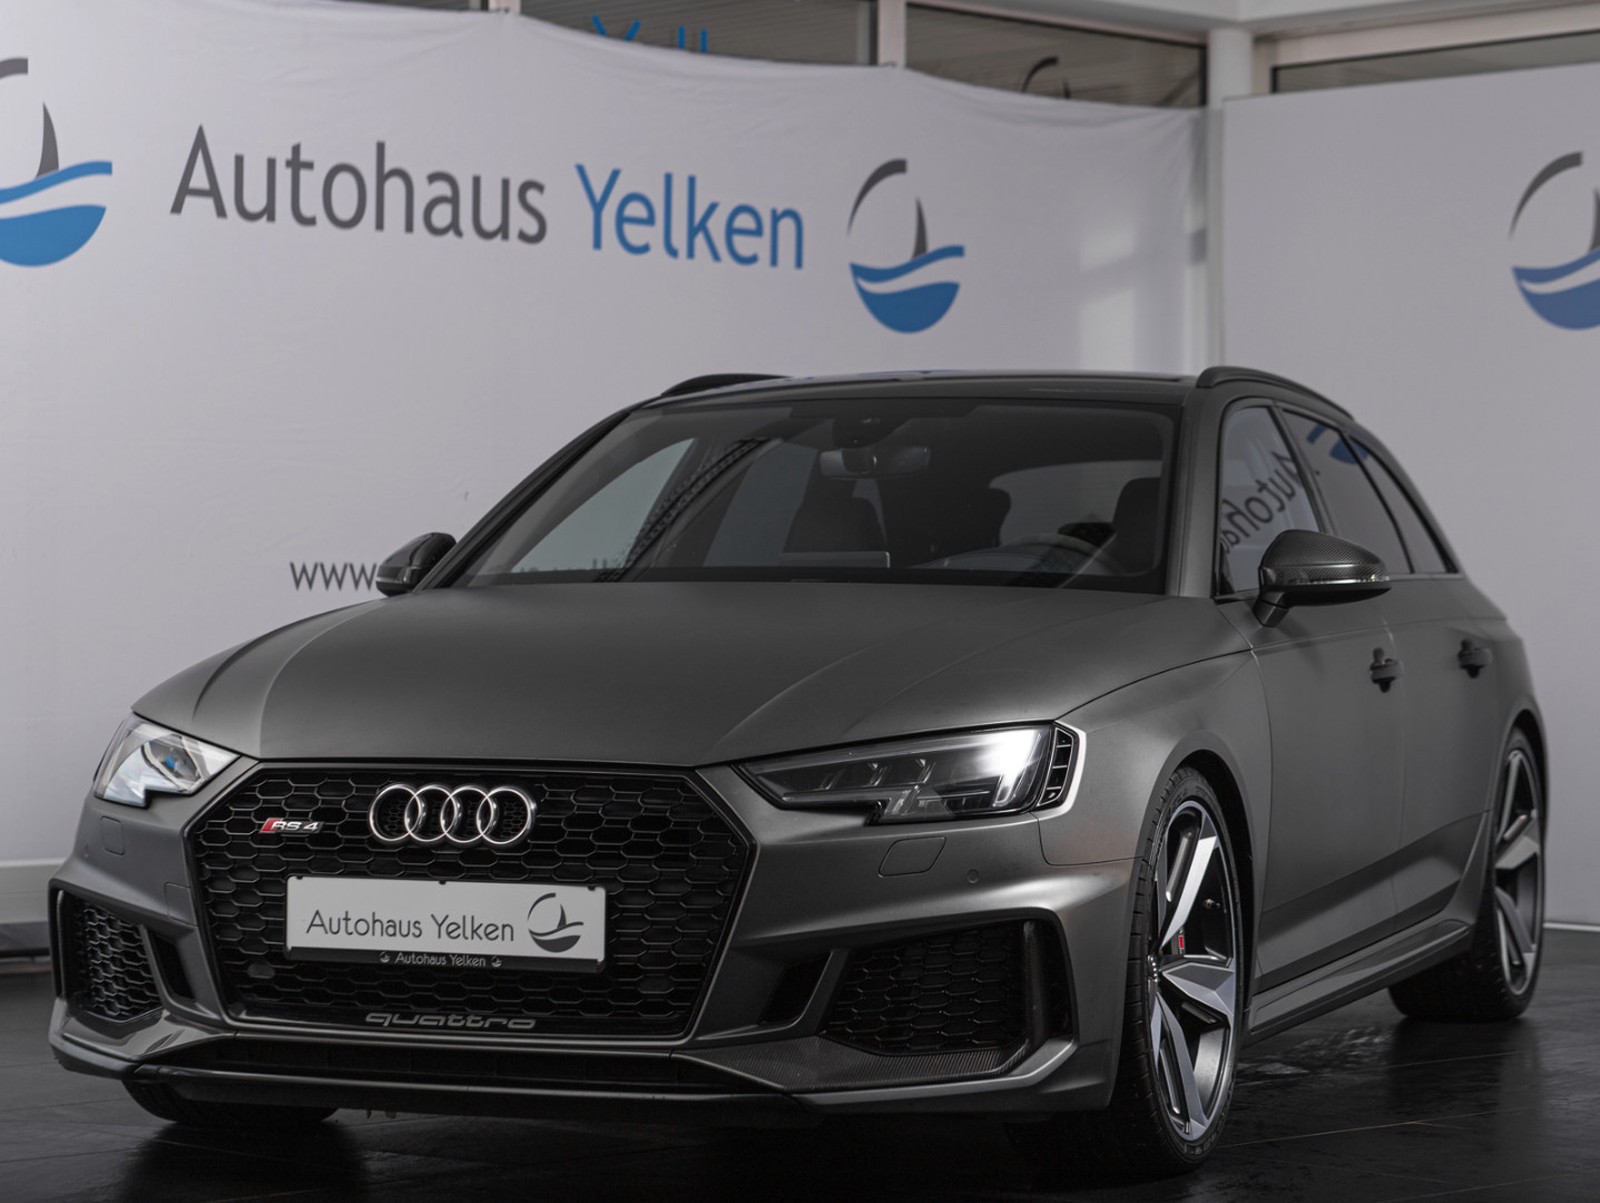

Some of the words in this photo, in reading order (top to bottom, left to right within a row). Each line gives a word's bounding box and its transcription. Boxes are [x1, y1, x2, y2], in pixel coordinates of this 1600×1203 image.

[170, 124, 548, 245] Autohaus
[575, 163, 804, 270] Yelken
[306, 909, 423, 939] Autohaus
[431, 913, 515, 942] Yelken
[395, 952, 447, 966] Autohaus
[449, 954, 486, 967] Yelken
[365, 1012, 536, 1029] quattro
